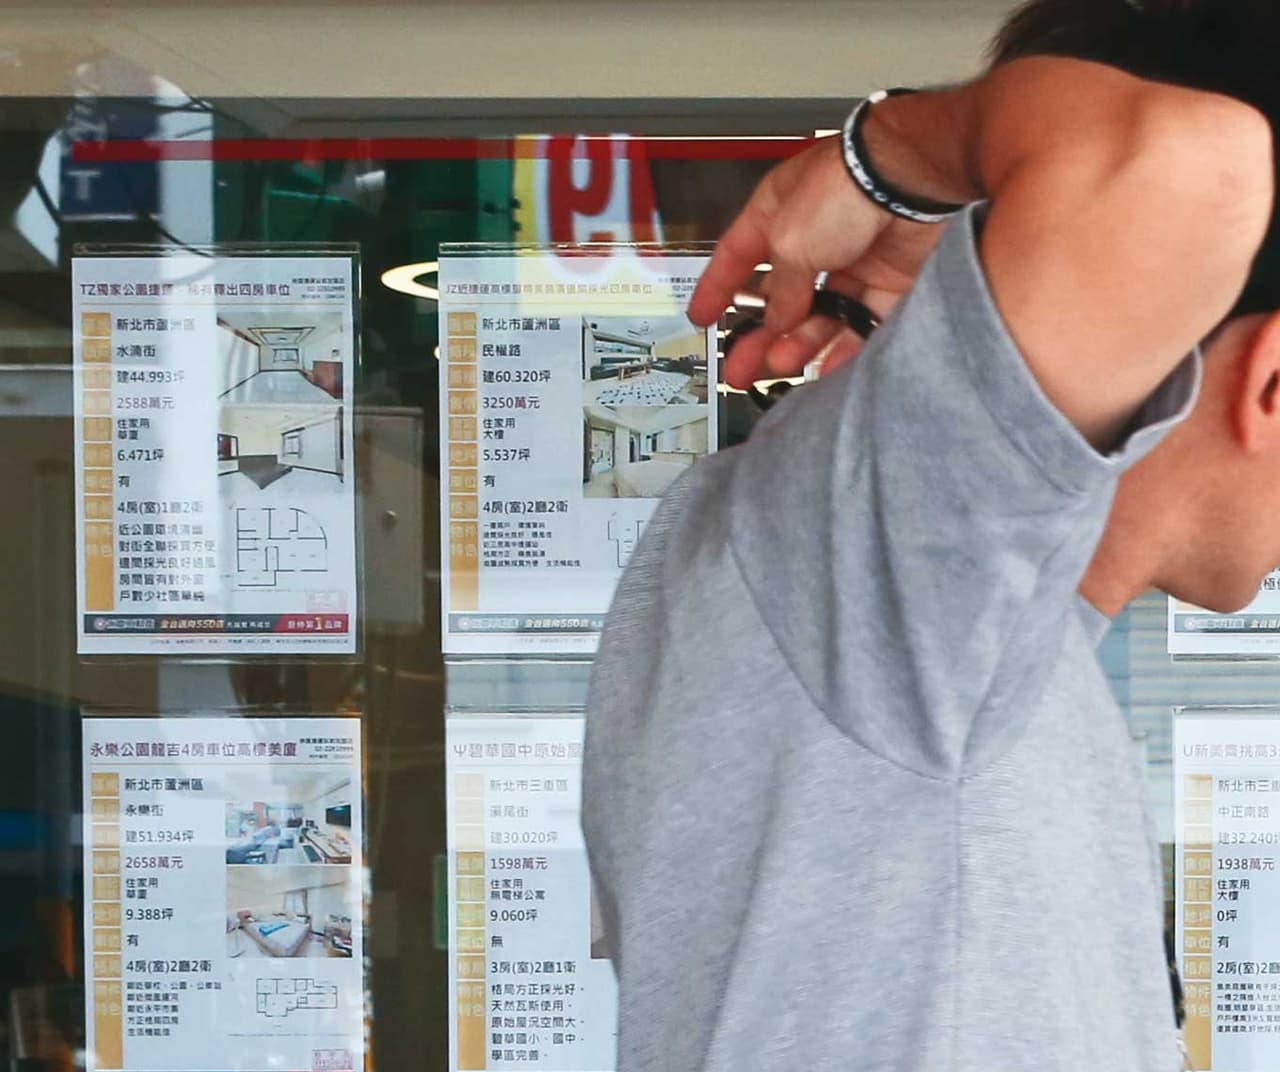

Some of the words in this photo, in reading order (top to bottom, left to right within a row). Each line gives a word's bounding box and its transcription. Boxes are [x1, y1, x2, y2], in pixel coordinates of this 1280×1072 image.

[483, 318, 560, 331] 新北市蘆洲區
[483, 344, 520, 357] 民權路
[483, 370, 551, 383] 建60.320坪
[117, 397, 174, 409] 2588萬元
[483, 396, 540, 409] 3250萬元
[483, 419, 516, 429] 住家用
[117, 446, 164, 462] 6.471坪
[483, 446, 530, 462] 5.537坪
[483, 500, 568, 514] 4房(室)2廳2衛
[125, 778, 203, 791] 新北市蘆洲區
[126, 830, 193, 843] 建51.934坪
[126, 856, 184, 869] 2658萬元
[491, 858, 547, 870] 1598萬元
[1218, 858, 1274, 871] 1938萬元
[491, 879, 523, 888] 住家用
[1218, 879, 1250, 890] 住家用
[490, 907, 538, 922] 9.060坪
[126, 960, 211, 973] 4房(室)2廳2衛
[491, 961, 576, 973] 3房(室)2廳1衛
